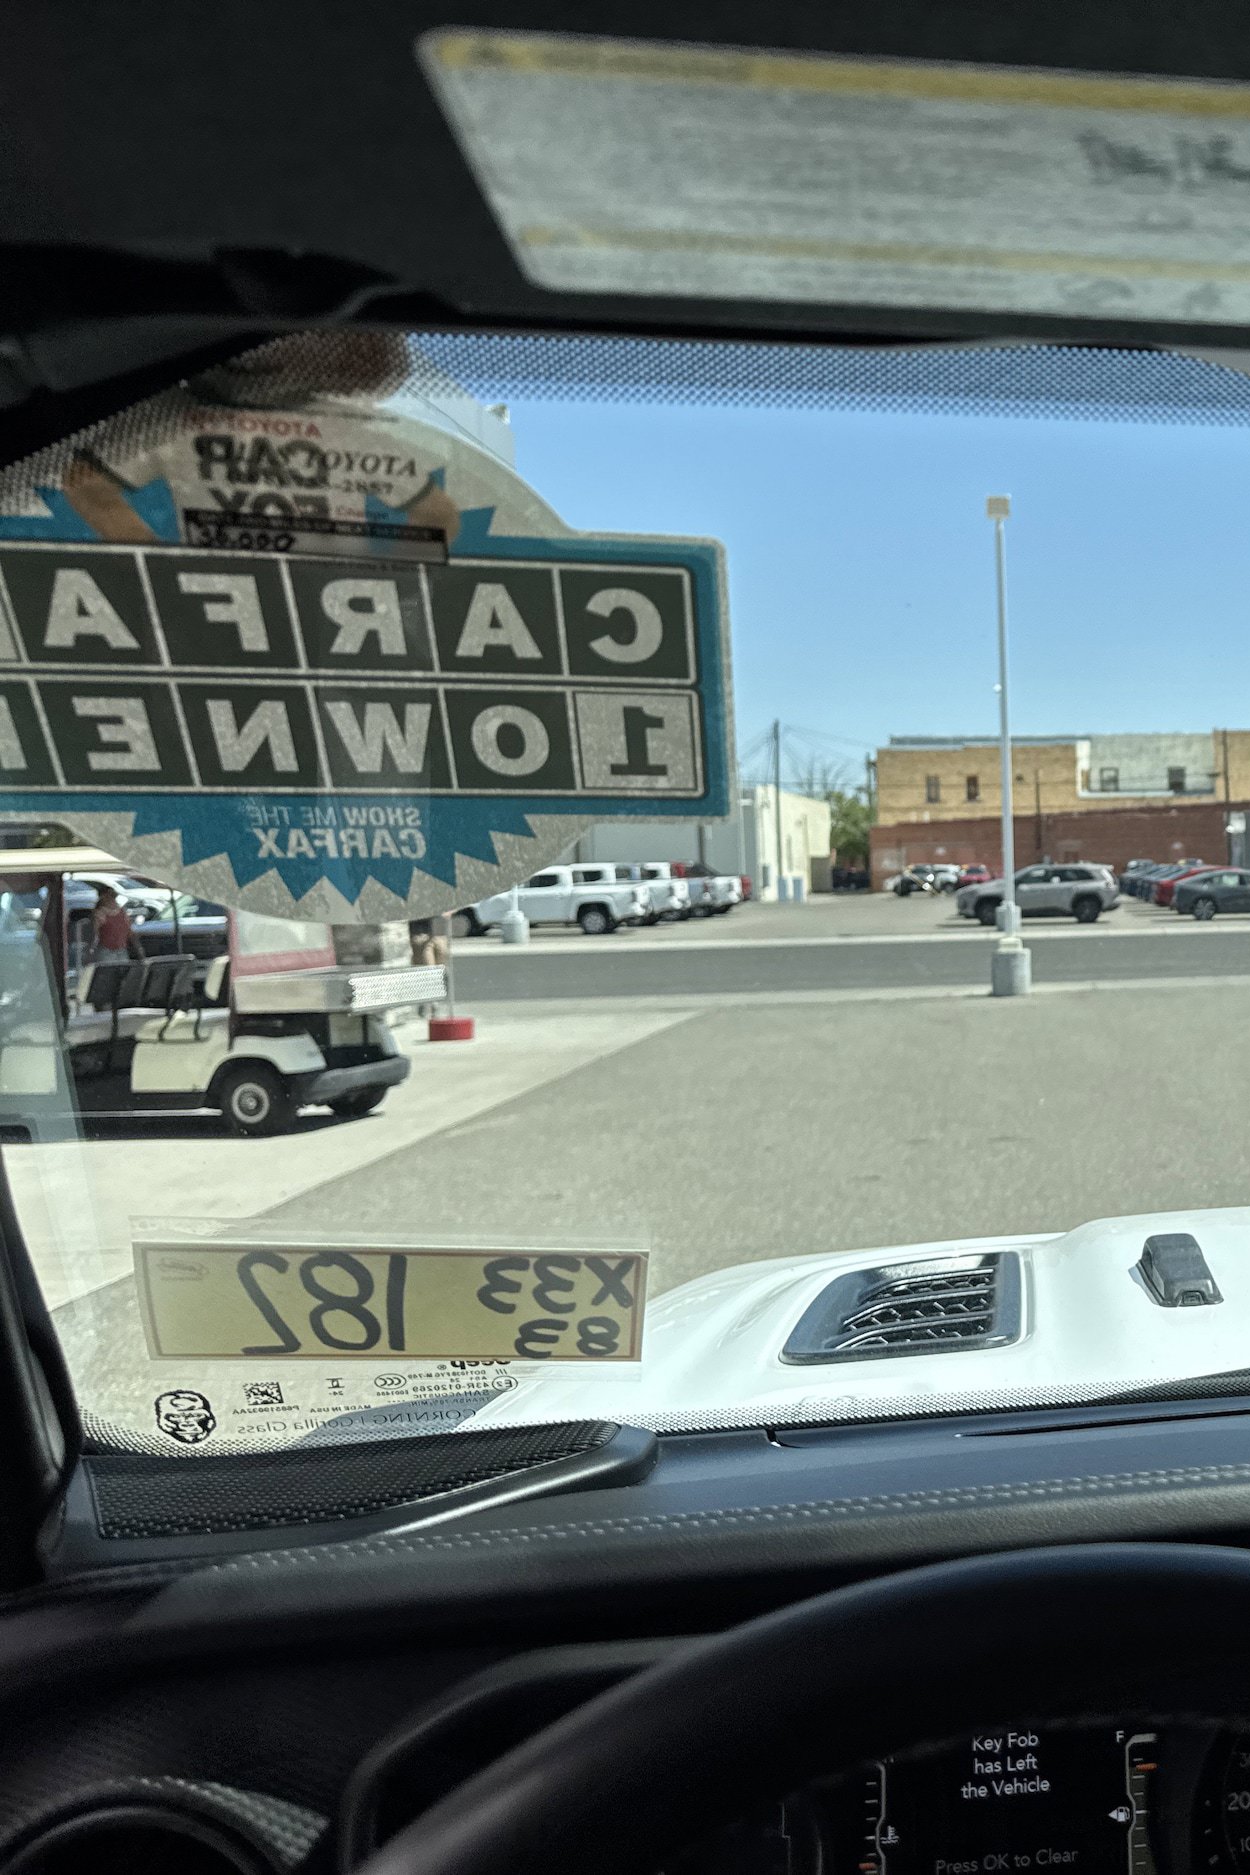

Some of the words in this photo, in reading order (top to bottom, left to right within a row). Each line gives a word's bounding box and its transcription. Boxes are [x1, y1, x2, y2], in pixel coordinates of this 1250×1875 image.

[972, 1734, 1002, 1753] Key
[1007, 1731, 1039, 1748] Fob
[1115, 1730, 1125, 1743] F
[974, 1757, 1002, 1775] has
[1006, 1754, 1038, 1773] Left
[960, 1781, 988, 1800] the
[991, 1776, 1051, 1797] Vehicle
[936, 1857, 979, 1875] Press
[984, 1852, 1009, 1872] OK
[1014, 1853, 1031, 1869] to
[1036, 1848, 1079, 1867] Clear
